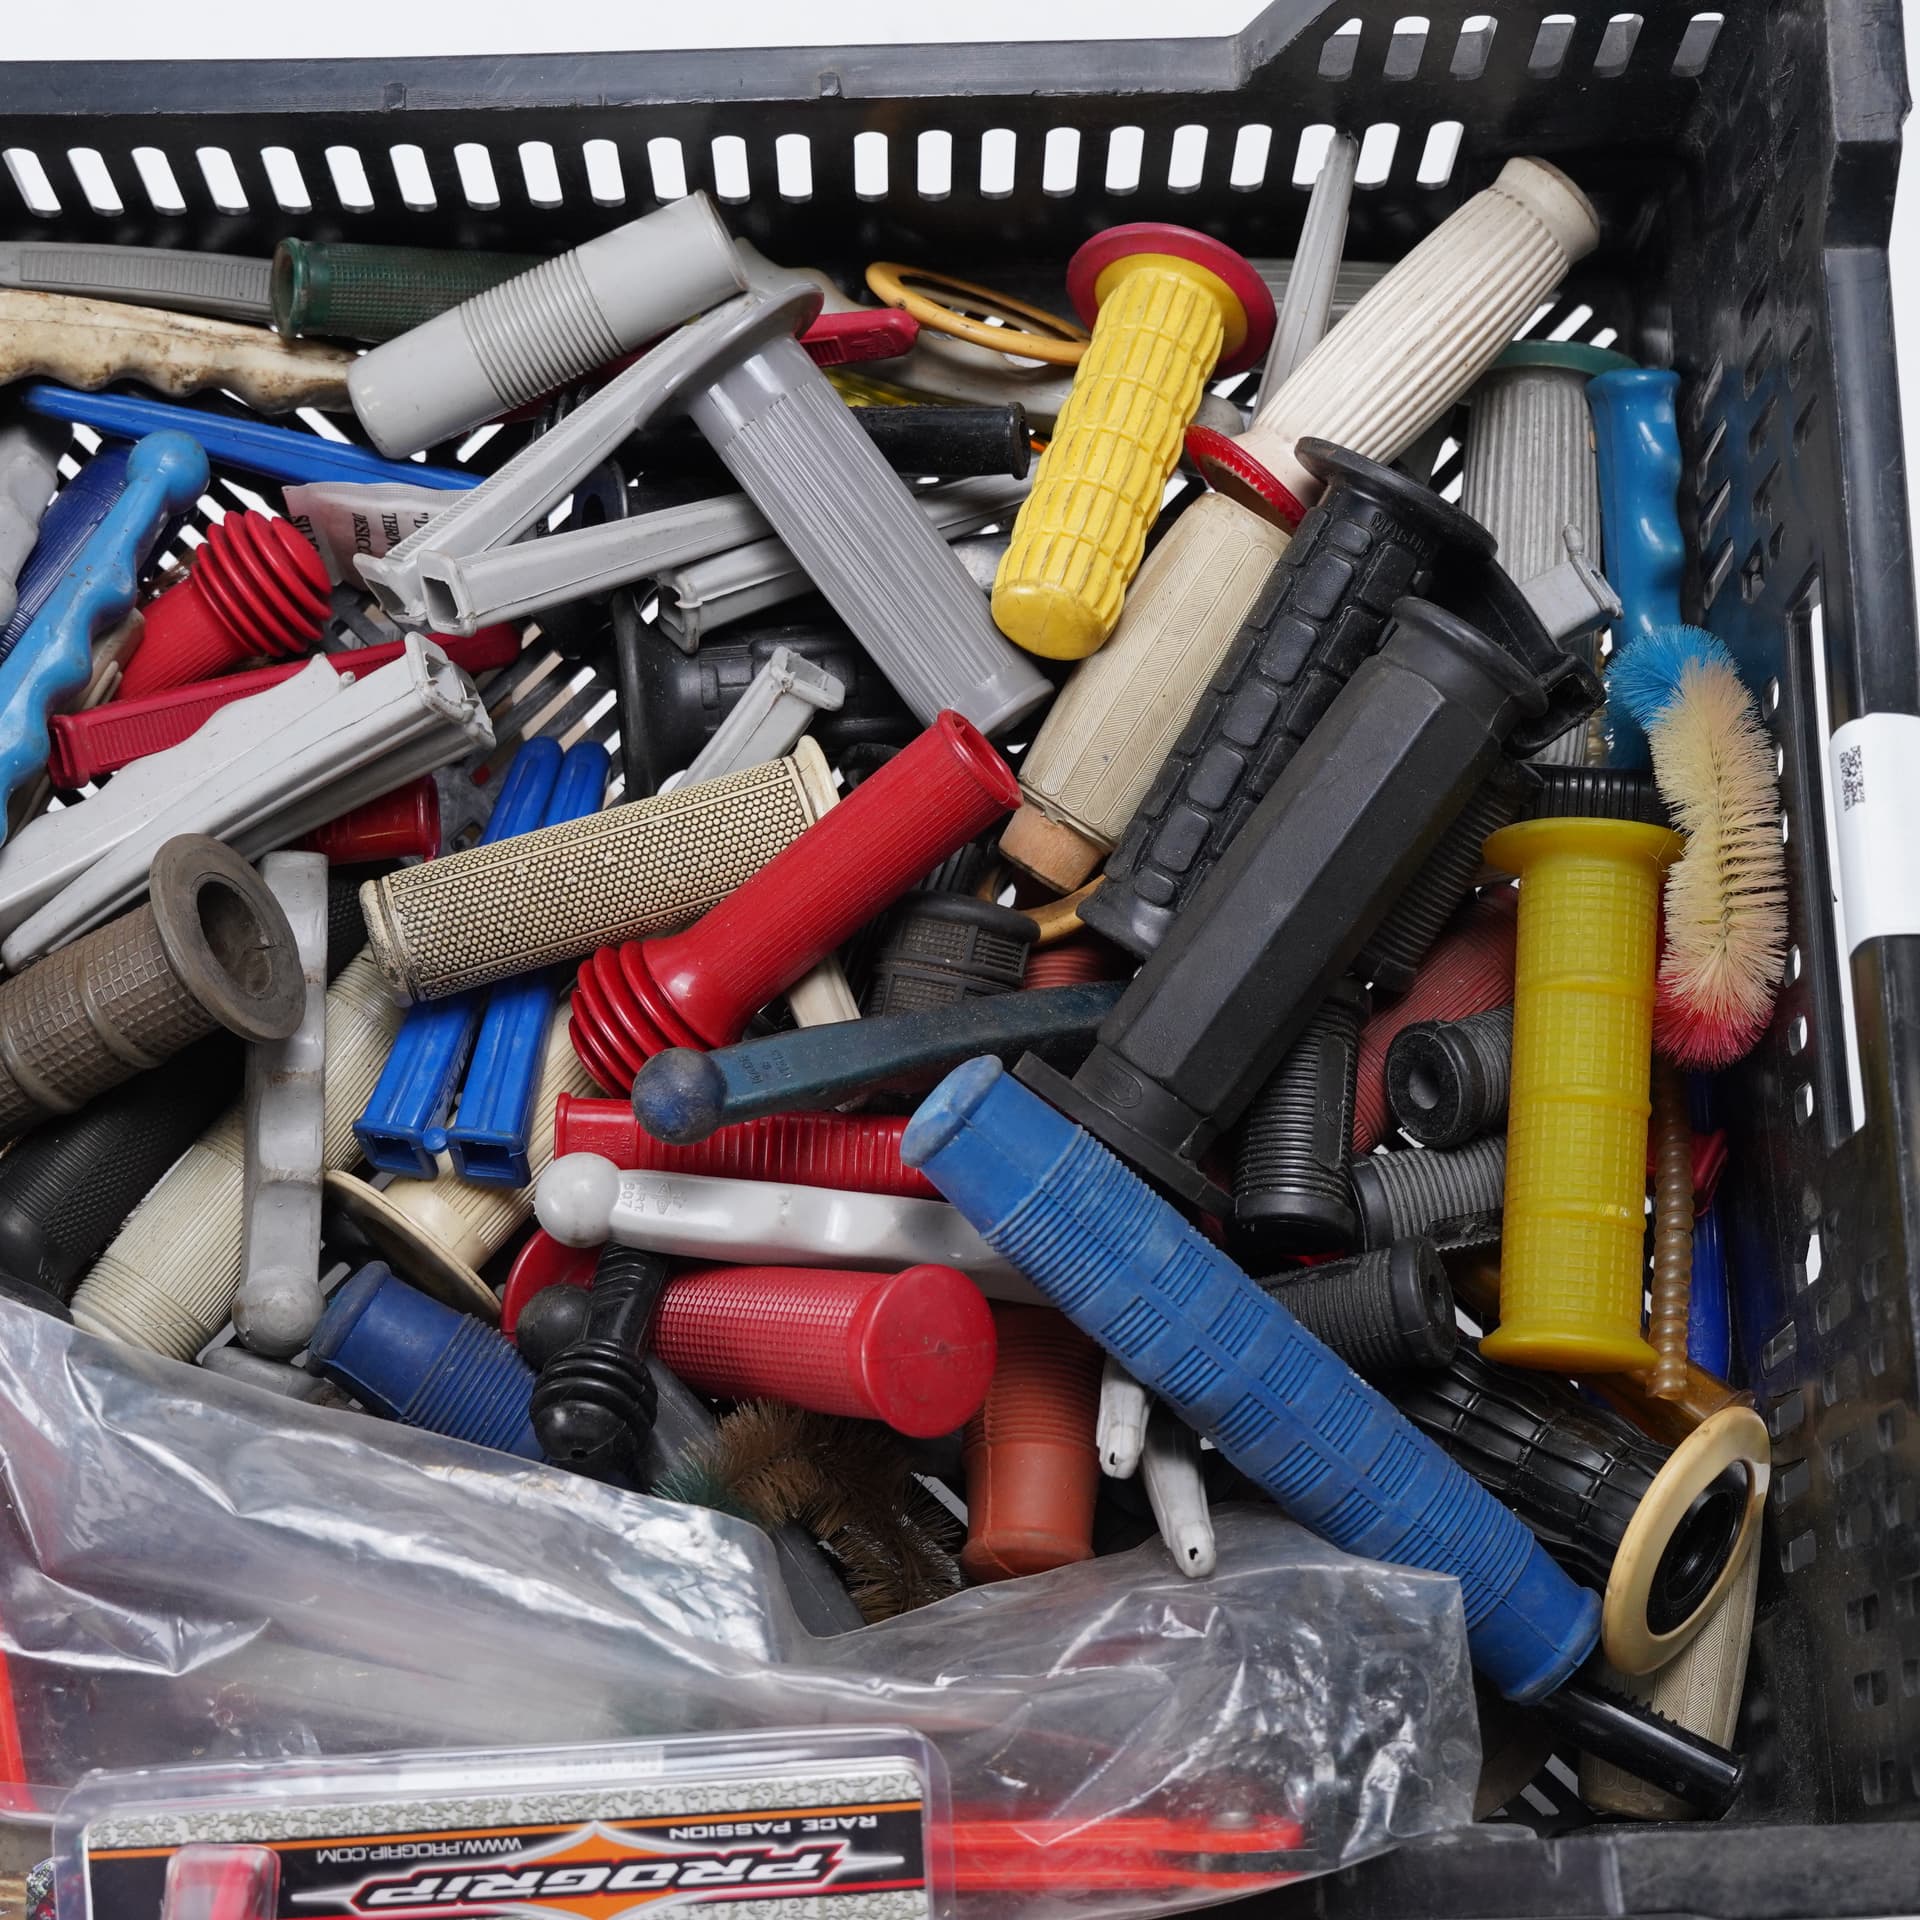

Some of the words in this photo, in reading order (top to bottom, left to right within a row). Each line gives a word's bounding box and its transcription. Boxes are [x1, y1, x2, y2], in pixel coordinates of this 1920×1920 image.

[669, 1820, 792, 1840] PASSION
[801, 1814, 878, 1832] RACE
[316, 1837, 522, 1864] WWW.PROGRIP.COM
